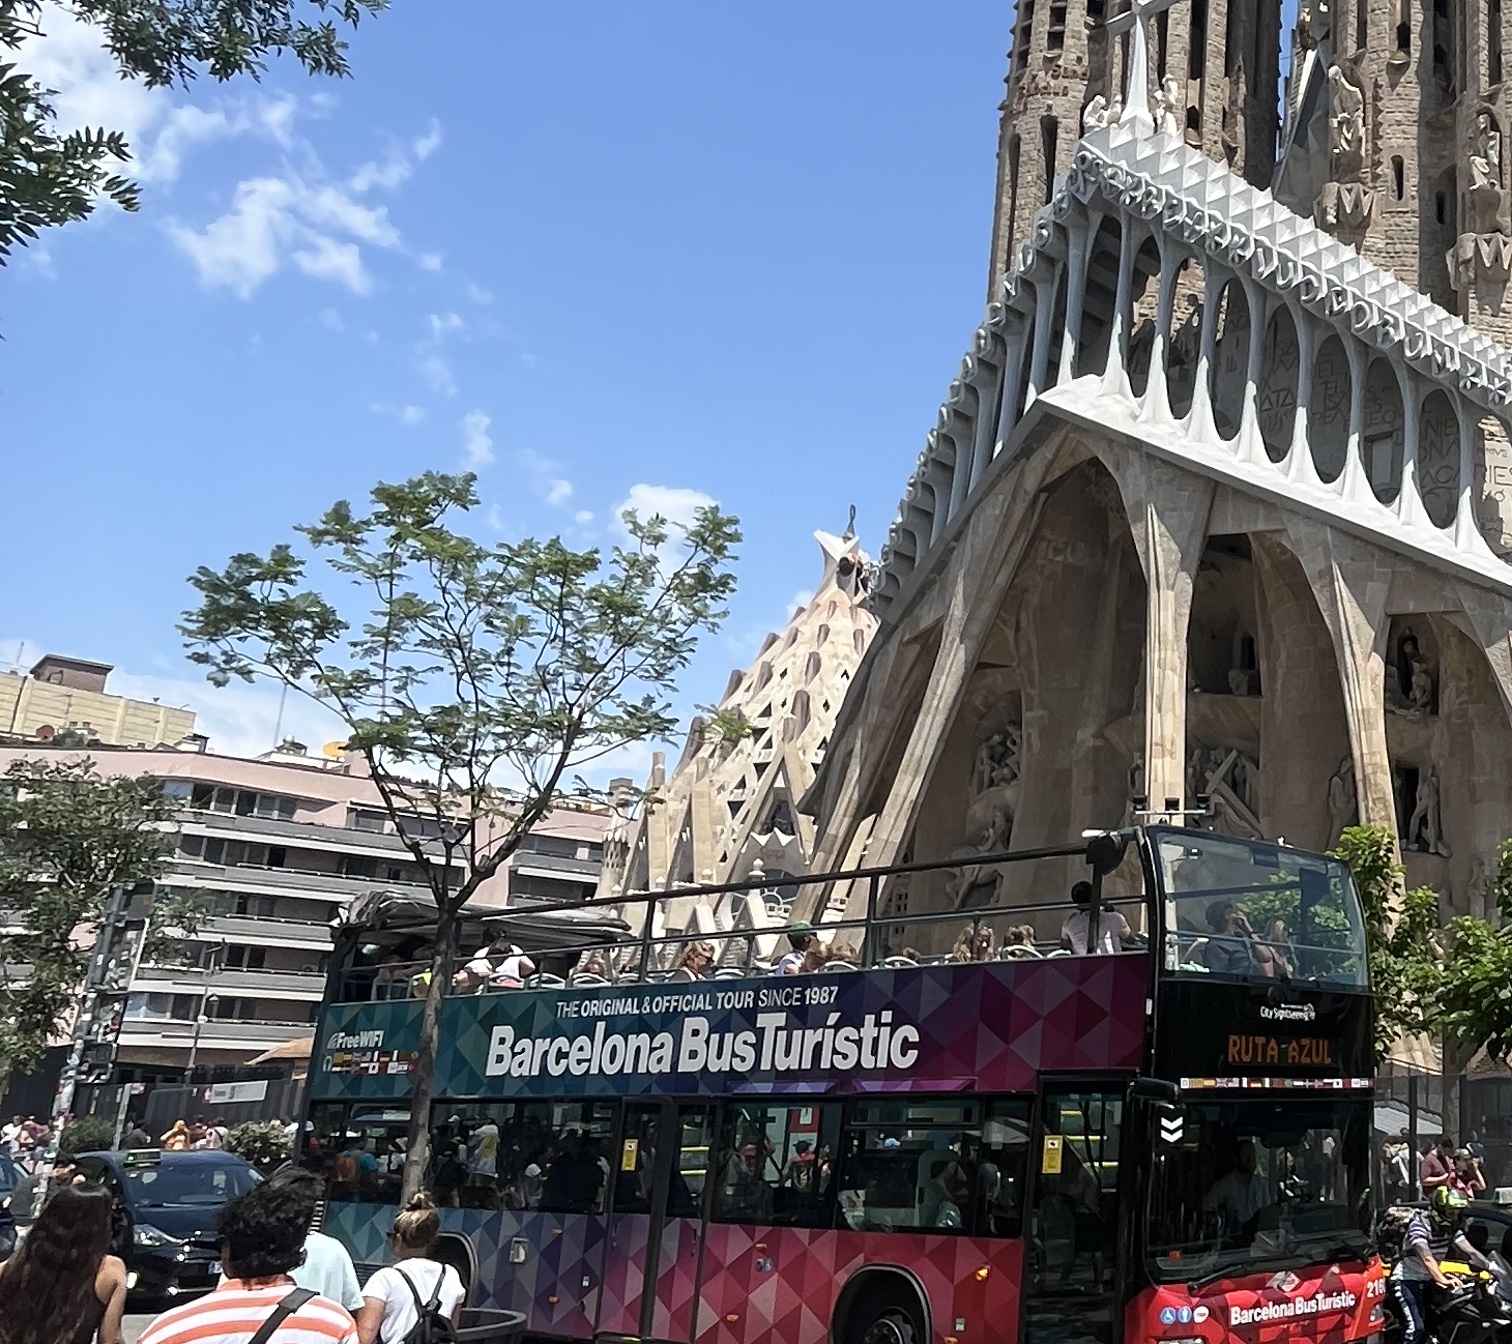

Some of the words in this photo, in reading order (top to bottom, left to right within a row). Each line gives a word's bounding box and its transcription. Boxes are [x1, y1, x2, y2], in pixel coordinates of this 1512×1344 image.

[556, 1001, 580, 1018] THE
[580, 996, 640, 1017] ORIGINAL
[641, 1001, 651, 1014] &
[652, 993, 713, 1015] OFFICIAL
[716, 990, 755, 1009] TOUR
[757, 987, 802, 1007] SINCE
[803, 985, 839, 1005] 1987
[485, 1021, 674, 1078] Barcelona
[1228, 1034, 1279, 1064] RUTA
[1287, 1036, 1332, 1065] AZUL
[1230, 1299, 1295, 1326] Barcelona
